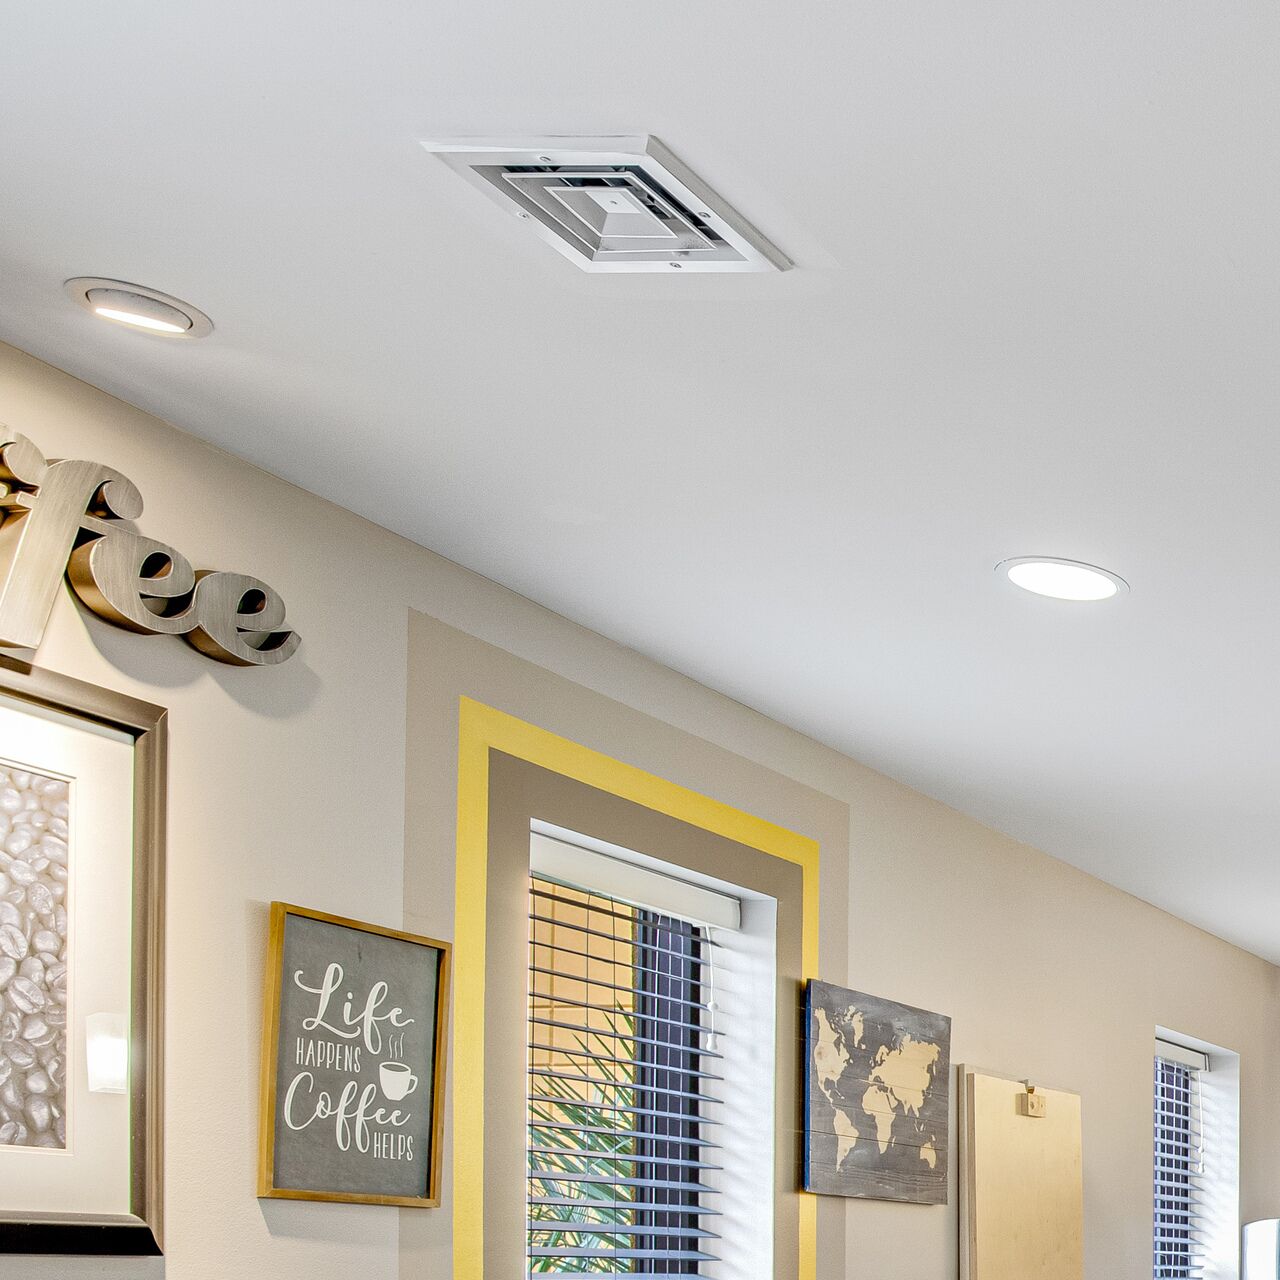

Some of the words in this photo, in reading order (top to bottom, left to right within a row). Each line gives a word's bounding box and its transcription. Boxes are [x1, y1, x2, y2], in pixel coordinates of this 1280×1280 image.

[294, 963, 414, 1054] Life
[296, 1037, 361, 1073] HAPPENS
[284, 1071, 411, 1153] Coffee
[373, 1132, 414, 1161] HELPS
